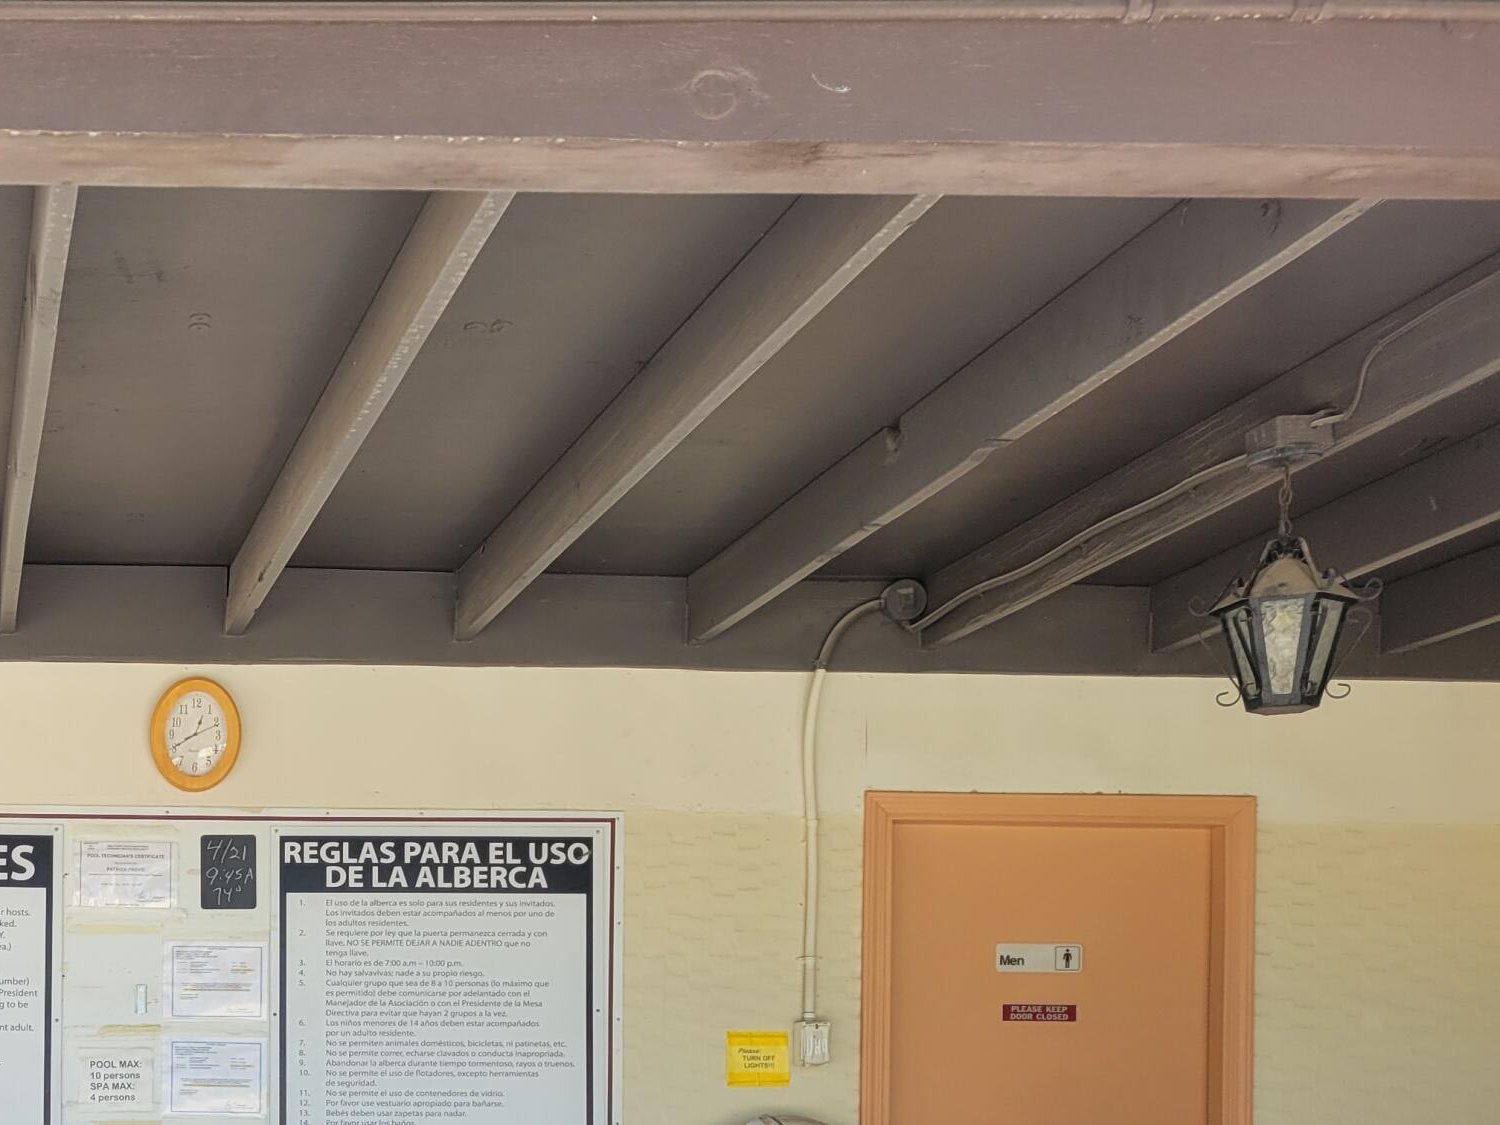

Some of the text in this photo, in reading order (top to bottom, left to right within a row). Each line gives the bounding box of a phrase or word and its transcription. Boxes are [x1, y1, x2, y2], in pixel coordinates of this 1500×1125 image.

[192, 698, 202, 708] 12
[180, 704, 188, 715] 11
[208, 704, 212, 714] 1
[172, 717, 181, 727] 10
[169, 729, 174, 739] 9
[215, 731, 221, 741] 3
[179, 756, 185, 766] 7
[206, 756, 212, 767] 5
[192, 762, 198, 773] 6
[207, 838, 247, 864] 4/21
[284, 841, 590, 865] REGLAS PARA EL USO
[325, 866, 549, 889] DE LA ALBERCA
[300, 958, 305, 966] 3.
[326, 958, 332, 966] El
[334, 958, 361, 966] horario
[373, 958, 383, 966] de
[425, 959, 445, 967] 10:00
[446, 961, 463, 969] p.m.
[999, 955, 1025, 966] Men
[1011, 1005, 1068, 1013] PLEASE KEEP
[1036, 1013, 1069, 1021] CLOSED
[90, 1060, 143, 1068] POOL MAX:
[90, 1072, 141, 1081] 10 persons
[90, 1082, 135, 1091] SPA MAX:
[98, 1094, 136, 1103] persons
[300, 1118, 310, 1125] 14.
[326, 1118, 338, 1125] Por
[340, 1118, 359, 1125] favor
